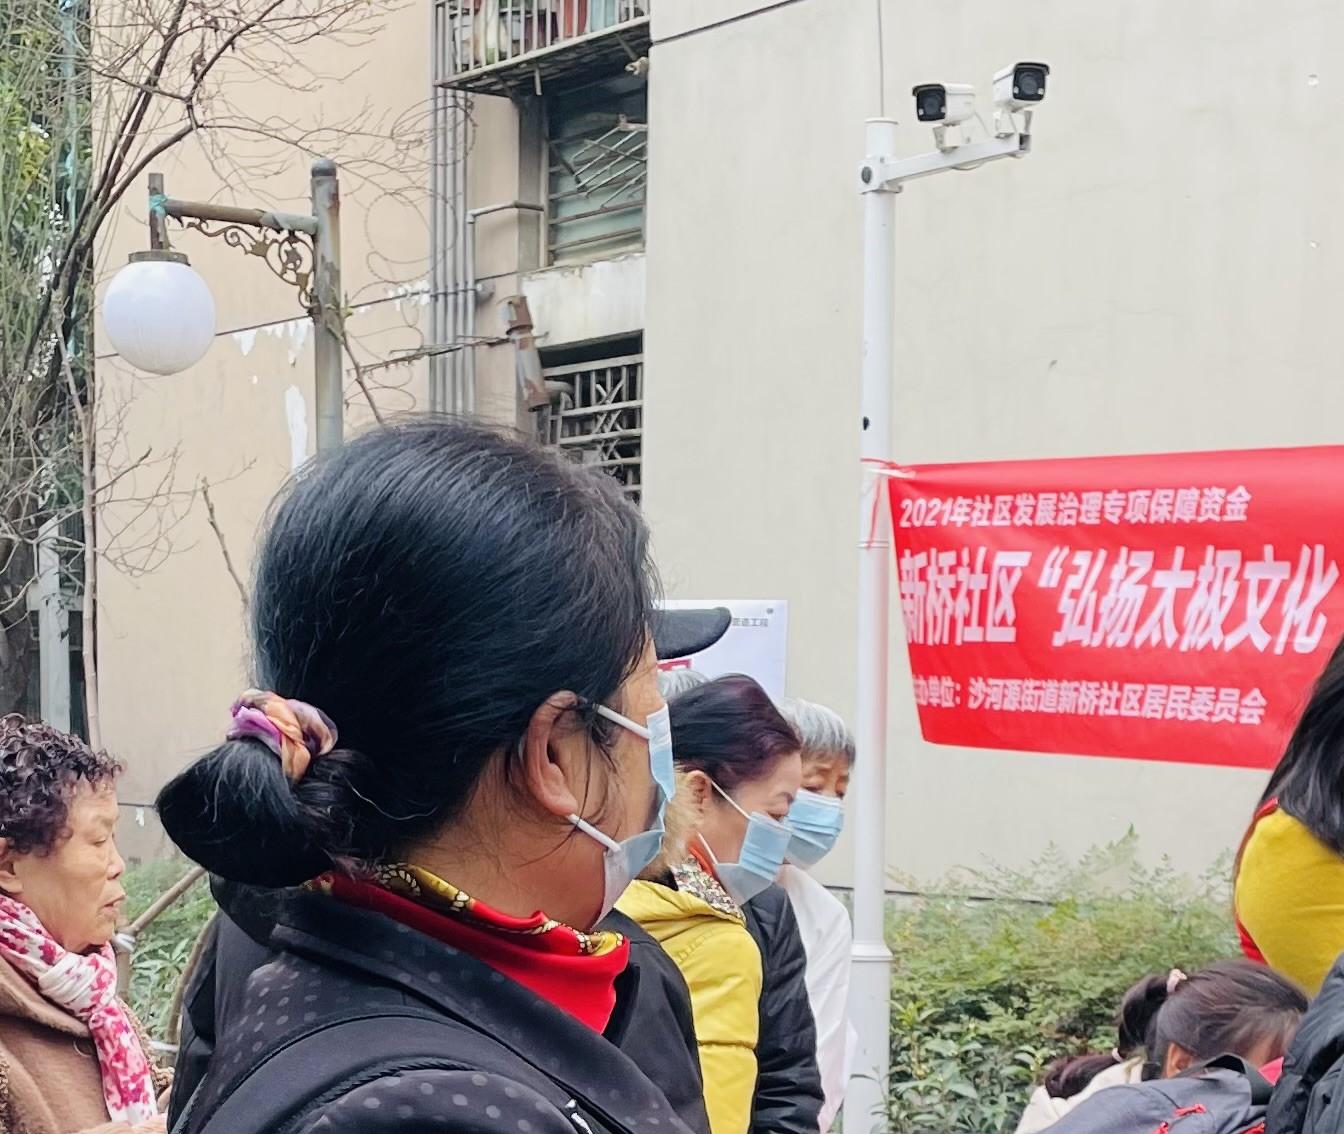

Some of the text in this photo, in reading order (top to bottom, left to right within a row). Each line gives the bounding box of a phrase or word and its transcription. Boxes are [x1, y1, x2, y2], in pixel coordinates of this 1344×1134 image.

[900, 486, 1251, 527] 2021年社区发展治理专项保障资金
[912, 675, 1267, 724] 办单位：沙河源街道新桥社区居民委员会
